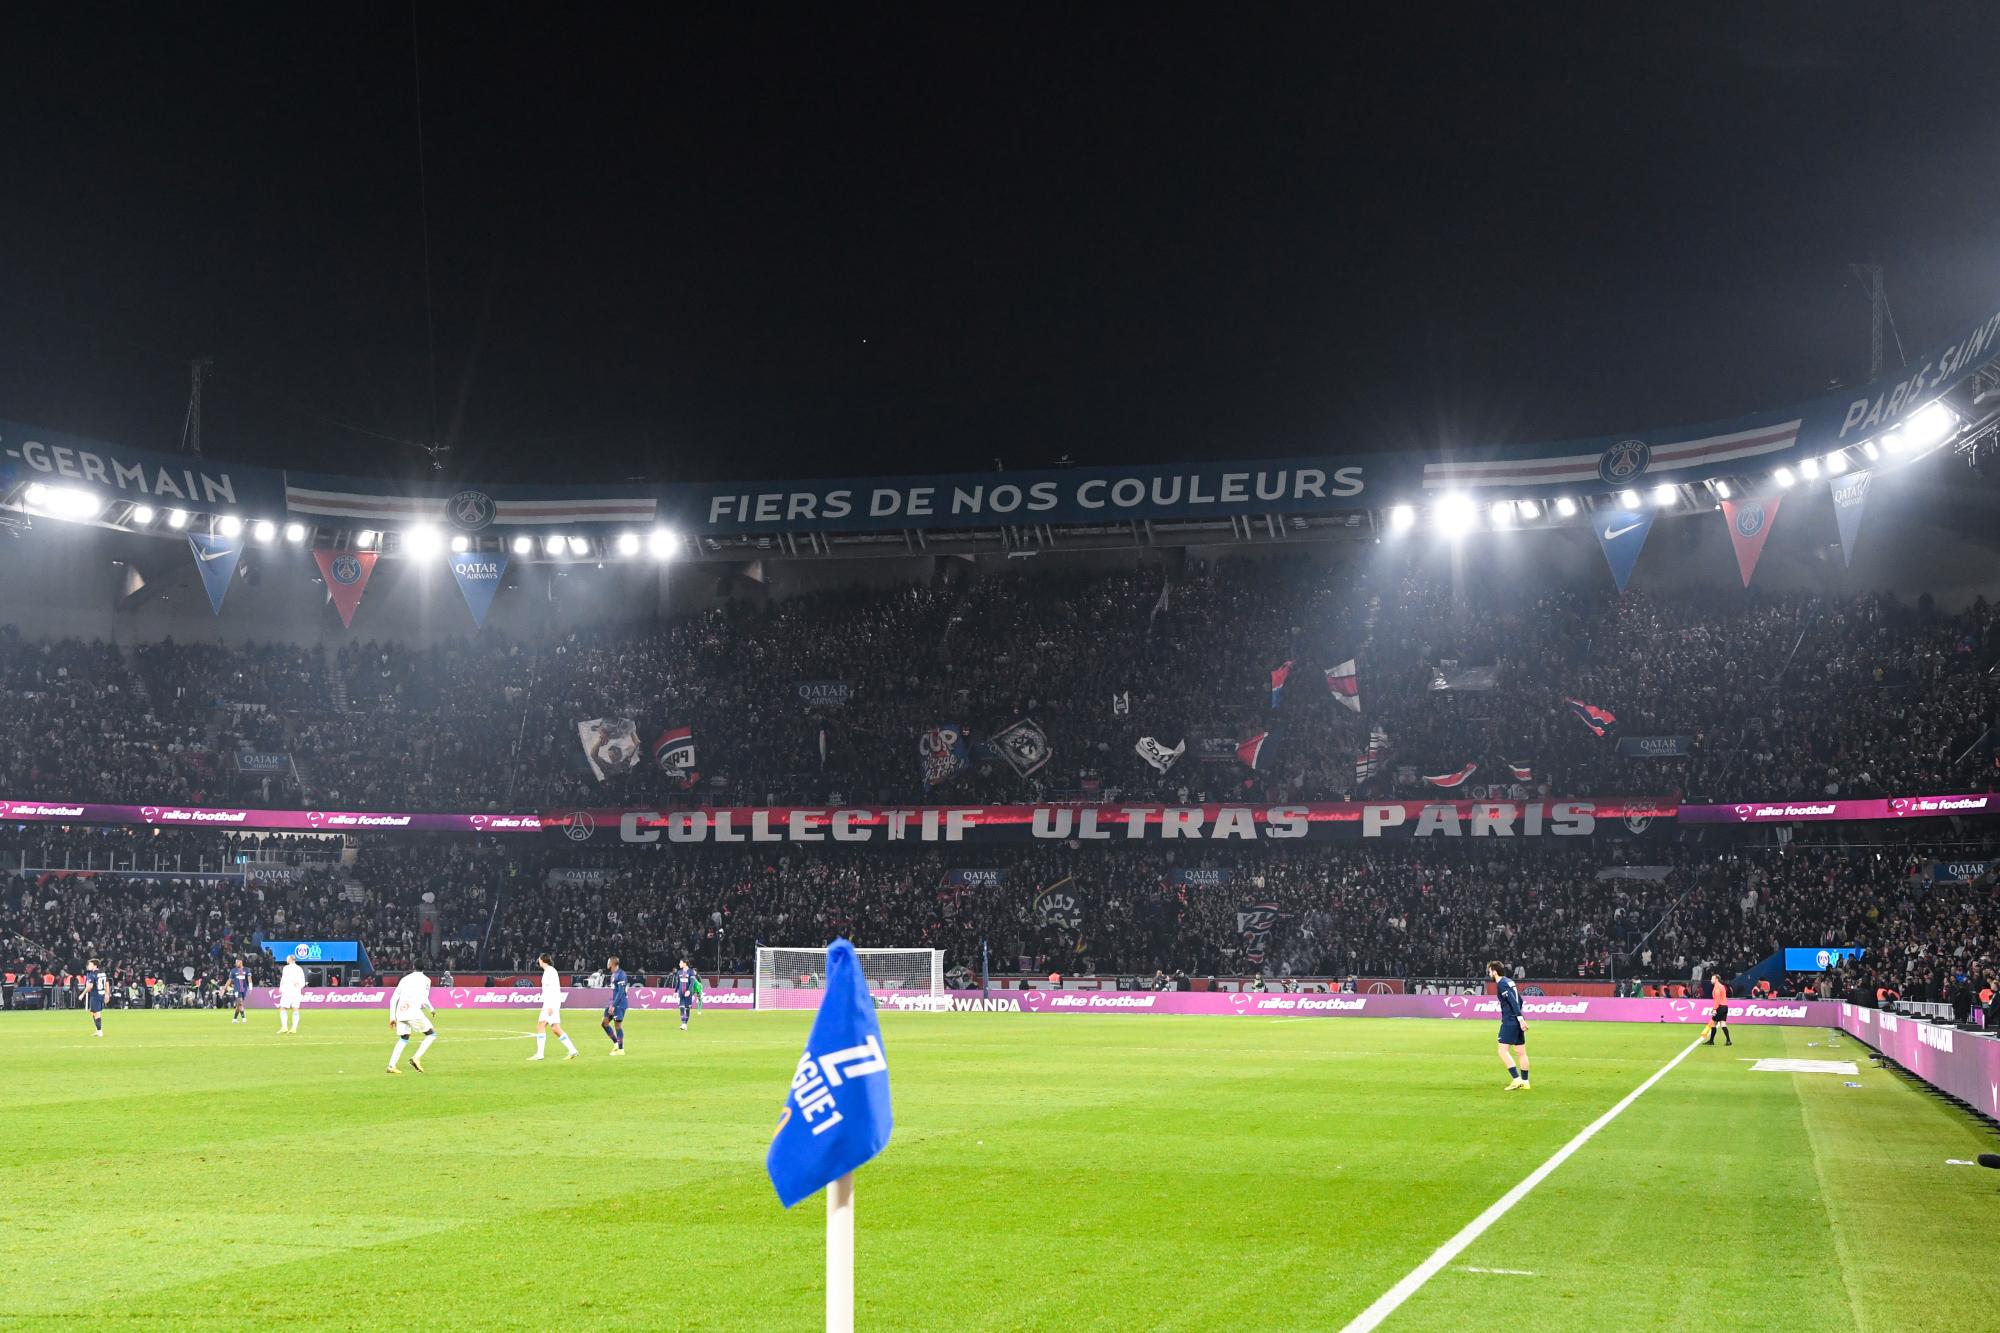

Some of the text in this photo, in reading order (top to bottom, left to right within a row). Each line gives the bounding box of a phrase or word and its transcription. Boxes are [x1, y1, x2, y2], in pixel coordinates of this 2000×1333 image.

[1839, 362, 1932, 439] PARIS
[709, 467, 1366, 524] FIERS DE NOS COULEURS
[456, 563, 497, 574] QATAR
[800, 685, 849, 699] QATAR
[1641, 739, 1676, 750] QATAR
[245, 755, 279, 766] QATAR
[1939, 798, 1988, 810] football
[12, 806, 84, 816] nike football
[163, 810, 246, 821] nike football
[1756, 804, 1836, 816] nike football
[329, 816, 411, 825] nike football
[492, 818, 520, 827] nike
[620, 802, 1597, 842] COLLECTIF ULTRAS PARIS
[255, 870, 290, 880] QATAR
[567, 871, 600, 880] QATAR
[1185, 870, 1219, 881] QATAR
[1949, 864, 1985, 876] QATAR
[963, 871, 998, 881] QATAR
[325, 991, 386, 1003] football
[474, 992, 508, 1003] nike
[1051, 996, 1156, 1007] nike football
[944, 998, 1021, 1012] RWANDA
[1257, 998, 1367, 1010] nike football
[1746, 1005, 1808, 1018] football
